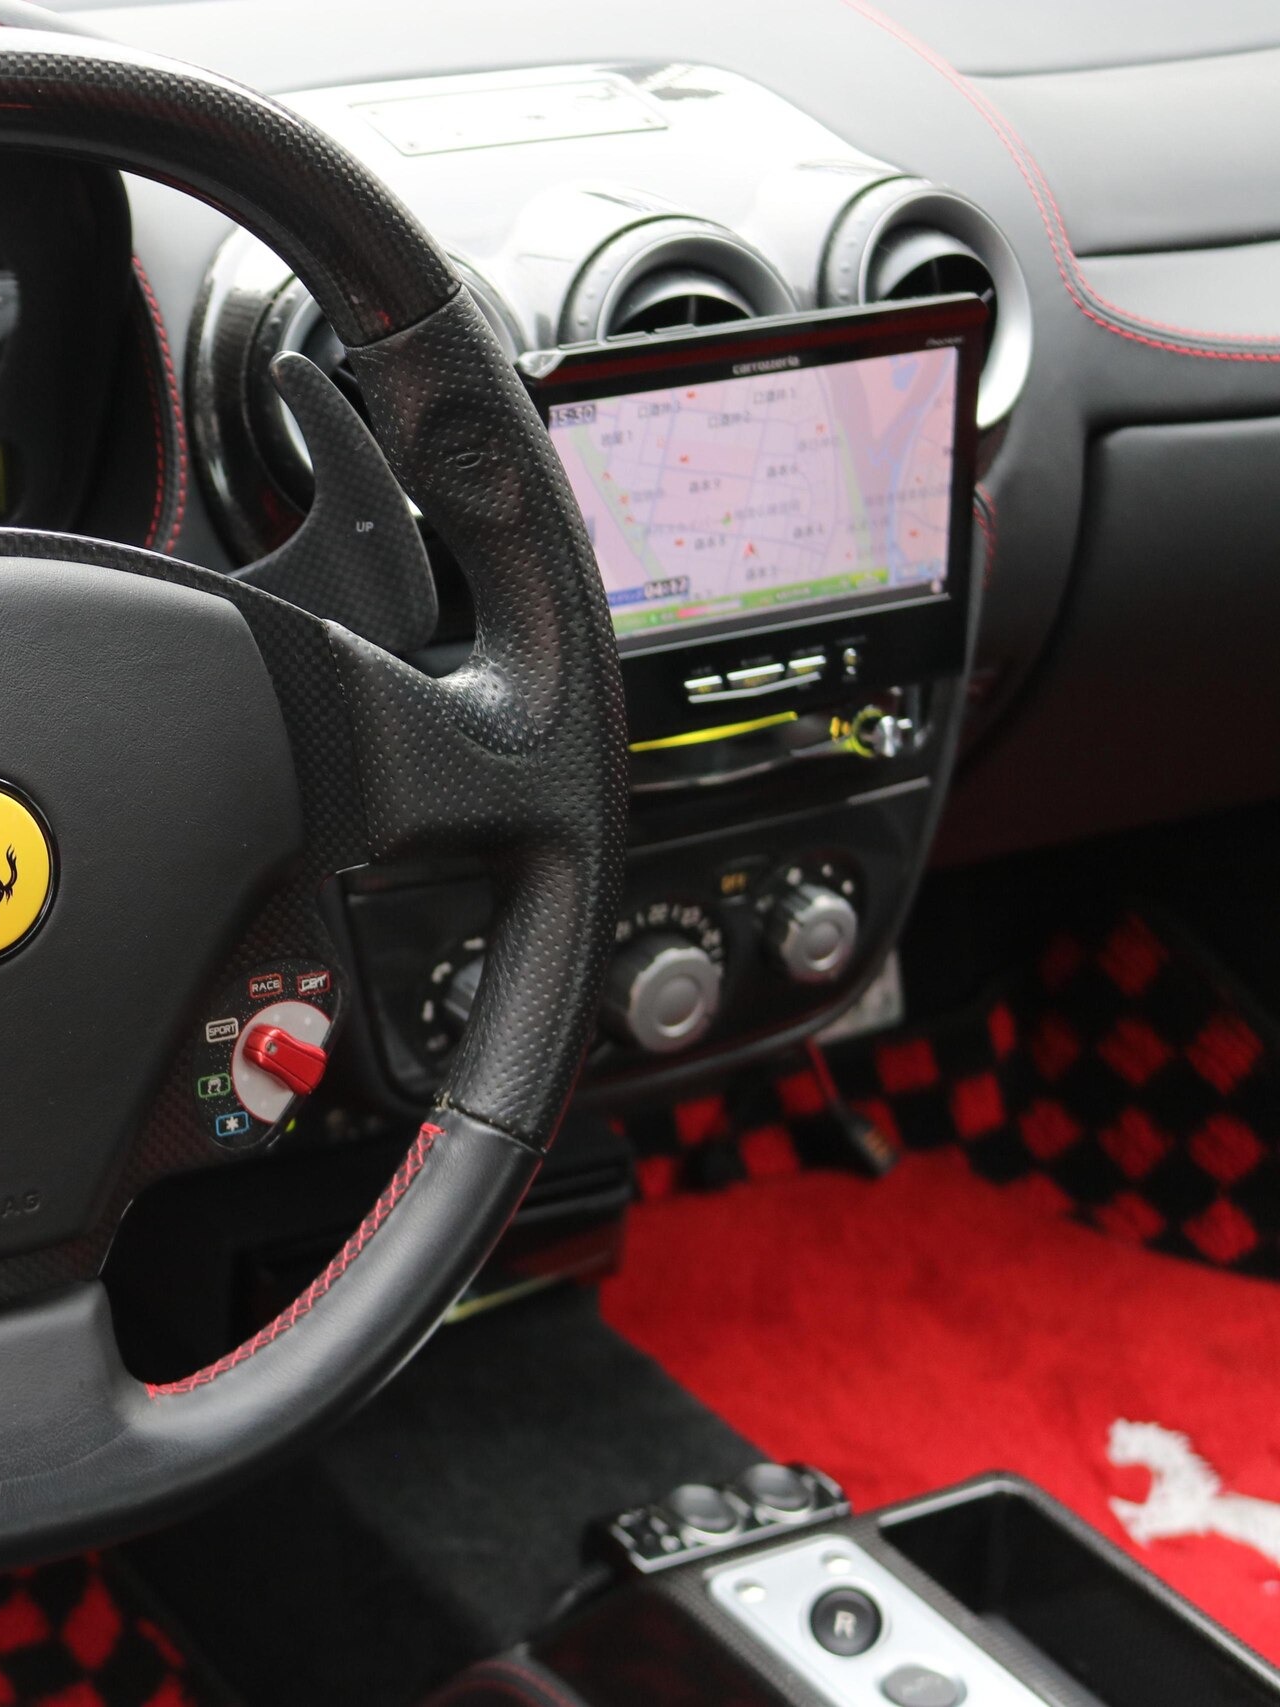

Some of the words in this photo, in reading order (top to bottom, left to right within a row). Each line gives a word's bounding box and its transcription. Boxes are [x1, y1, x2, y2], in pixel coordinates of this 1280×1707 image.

[356, 521, 374, 532] UP
[252, 979, 280, 992] RACE
[208, 1023, 237, 1036] SPORT
[834, 1610, 857, 1638] R
